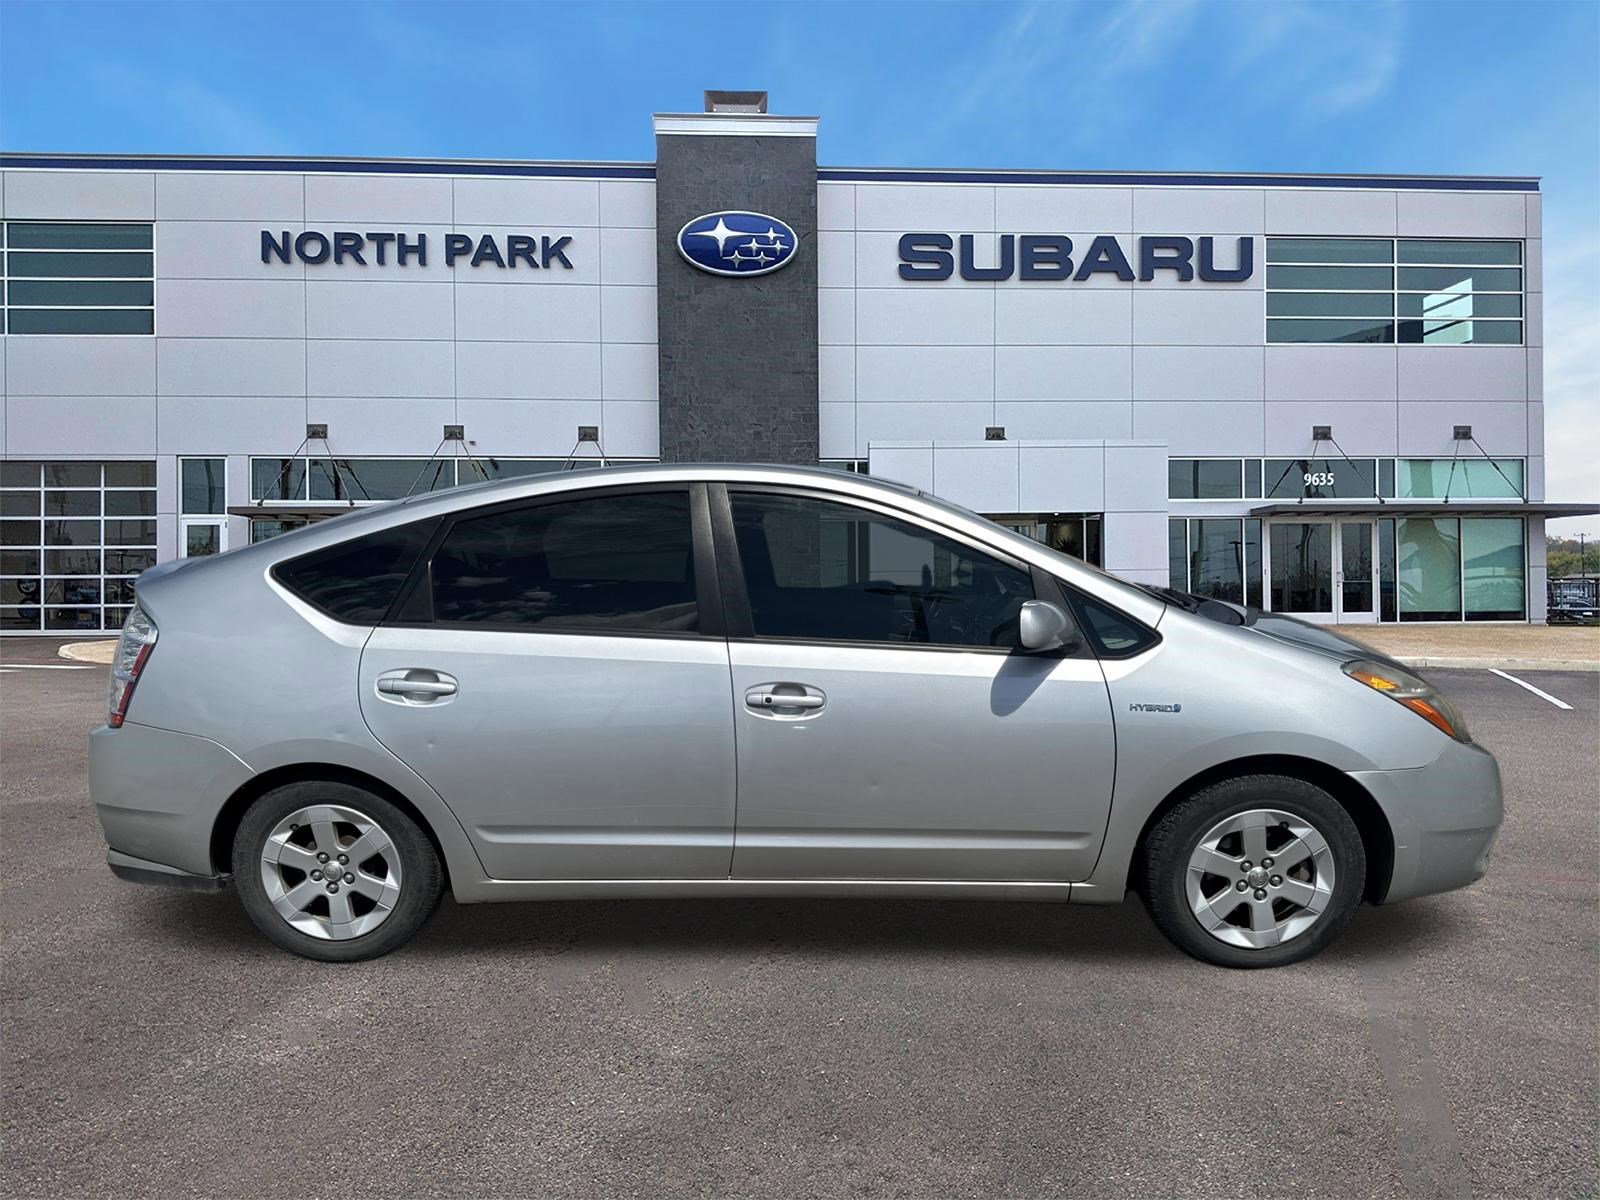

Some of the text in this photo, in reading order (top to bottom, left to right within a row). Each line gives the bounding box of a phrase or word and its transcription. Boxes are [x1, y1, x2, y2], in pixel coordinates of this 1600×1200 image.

[260, 230, 574, 269] NORTH PARK
[898, 233, 1254, 282] SUBARU
[1303, 472, 1335, 486] 9635
[1129, 703, 1173, 713] HYBRID
